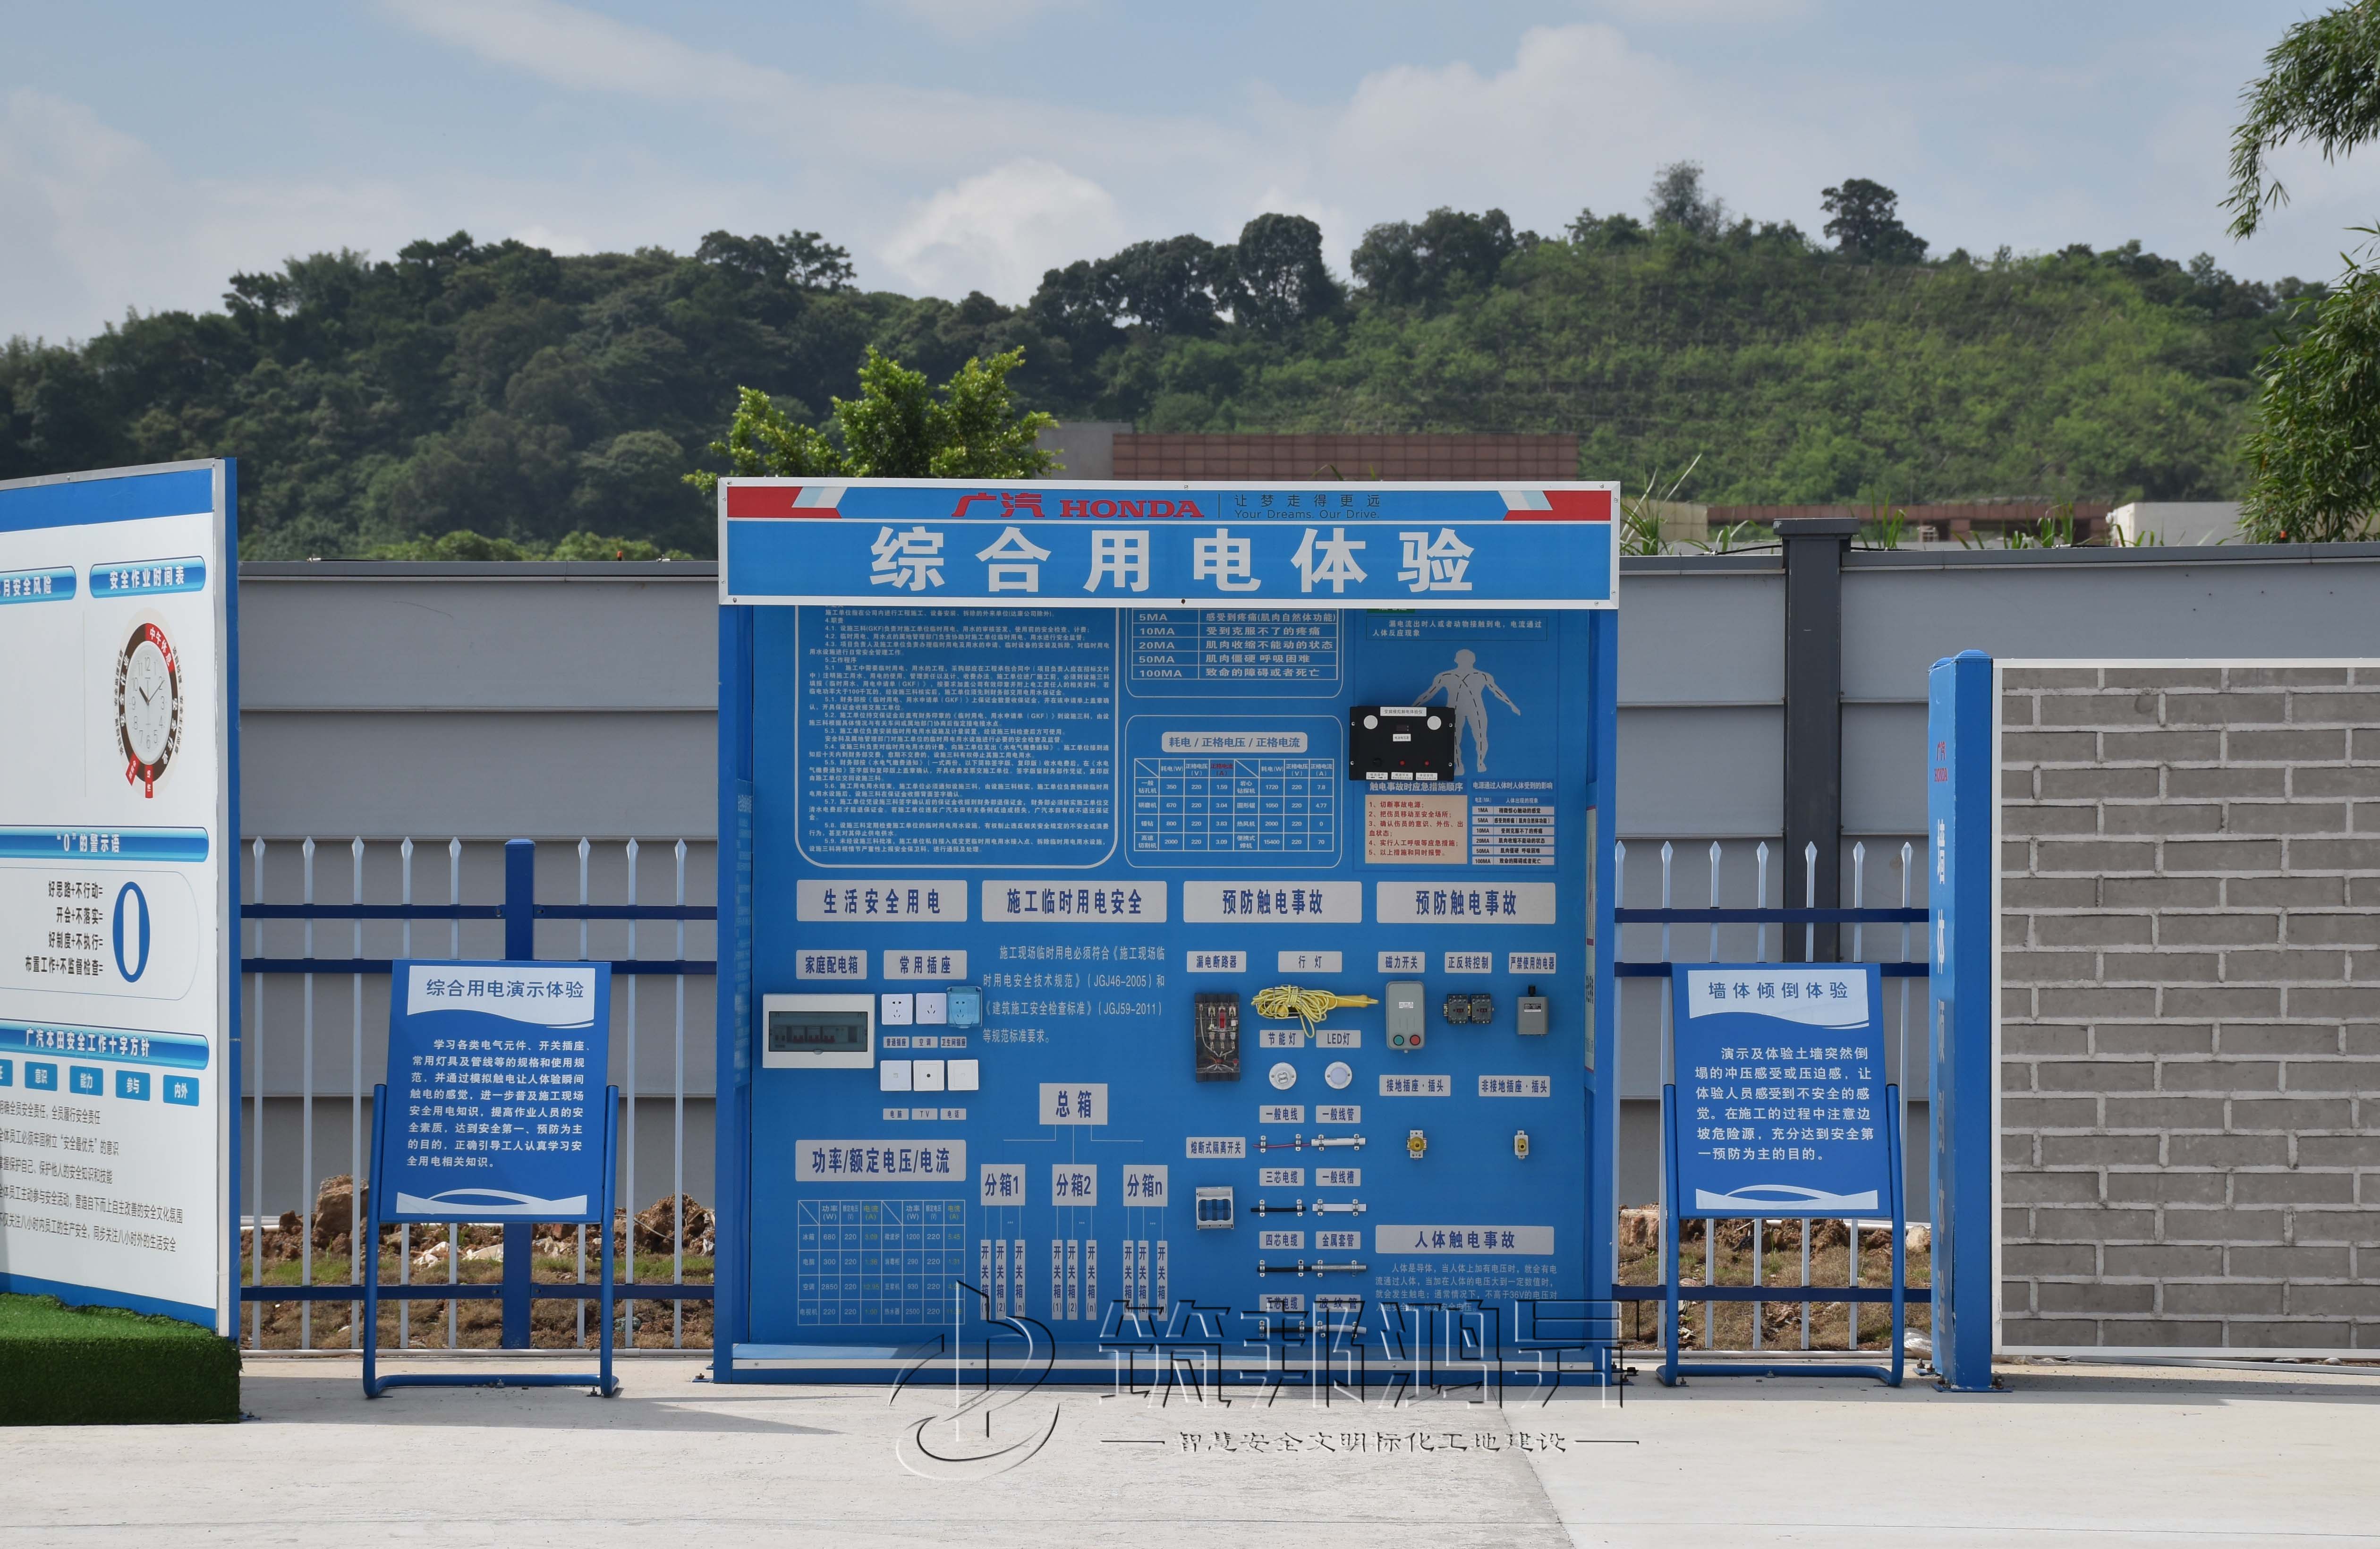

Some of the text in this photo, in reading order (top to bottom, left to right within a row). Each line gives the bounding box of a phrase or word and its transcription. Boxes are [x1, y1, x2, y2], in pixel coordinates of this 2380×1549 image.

[952, 492, 1045, 518] 广汽
[1060, 499, 1204, 518] HONDA
[1235, 494, 1380, 508] 让梦走得更远
[1235, 509, 1379, 519] Your Dreams. Our Drive.
[870, 525, 1474, 593] 综合用电体验
[110, 564, 185, 590] 安全作业时间表
[0, 575, 51, 597] 月安全风险
[1206, 613, 1336, 622] 感受到疼痛(肌肉自然体功能)
[1206, 627, 1320, 635] 受到克服不了的疼痛
[150, 627, 172, 667] 中午休息
[1206, 640, 1333, 649] 肌肉收缩不能动的状态
[1260, 655, 1310, 663] 呼吸困难
[1206, 668, 1320, 677] 致命的障碍或者死亡
[1370, 782, 1463, 792] 触电事故时应急措施顺序
[49, 881, 103, 899] 好思路+不行动=
[824, 888, 941, 914] 生活安全用电
[1007, 888, 1142, 914] 施工临时用电安全
[1223, 889, 1323, 915] 预防触电事故
[1416, 890, 1516, 916] 预防触电事故
[56, 907, 103, 924] 开会+不落实=
[113, 881, 150, 983] 0
[49, 931, 103, 950] 好制度+不执行=
[1000, 945, 1165, 960] 施工现场临时用电必须符合《施工现场临
[805, 956, 858, 975] 家庭配电箱
[900, 955, 951, 974] 常用插座
[1196, 955, 1237, 969] 漏电断路器
[1299, 955, 1322, 969] 行灯
[1386, 956, 1417, 969] 磁力开关
[1448, 956, 1488, 969] 正反转控制
[1511, 957, 1555, 970] 严禁使用的电器
[426, 979, 584, 998] 综合用电演示体验
[1708, 982, 1848, 999] 墙体倾倒体验
[26, 1027, 150, 1058] 广汽本田安全工作十字方针
[886, 1038, 906, 1047] 普通插座
[919, 1038, 931, 1047] 空调
[941, 1038, 966, 1047] 卫生间插座
[983, 1029, 1049, 1043] 等规范标准要求。
[1268, 1032, 1296, 1046] 节能灯
[1327, 1033, 1350, 1046] LED灯
[34, 1069, 47, 1084] 意识
[80, 1073, 93, 1089] 能力
[127, 1077, 139, 1094] 参与
[174, 1082, 188, 1099] 内外
[1056, 1090, 1092, 1118] 总箱
[890, 1110, 902, 1118] 电脑
[947, 1110, 960, 1118] 电话
[1266, 1107, 1298, 1121] 一般电线
[1322, 1107, 1354, 1121] 一般线管
[1191, 1141, 1241, 1155] 熔断式隔离开关
[812, 1148, 950, 1174] 功率/额定电压/电流
[985, 1173, 1019, 1197] 分箱1
[1056, 1173, 1091, 1197] 分箱2
[1266, 1171, 1298, 1184] 三芯电缆
[1322, 1171, 1354, 1184] 一般线槽
[1127, 1174, 1162, 1198] 分箱n
[1266, 1234, 1298, 1247] 四芯电缆
[1322, 1234, 1354, 1247] 金属套管
[1415, 1231, 1515, 1249] 人体触电事故
